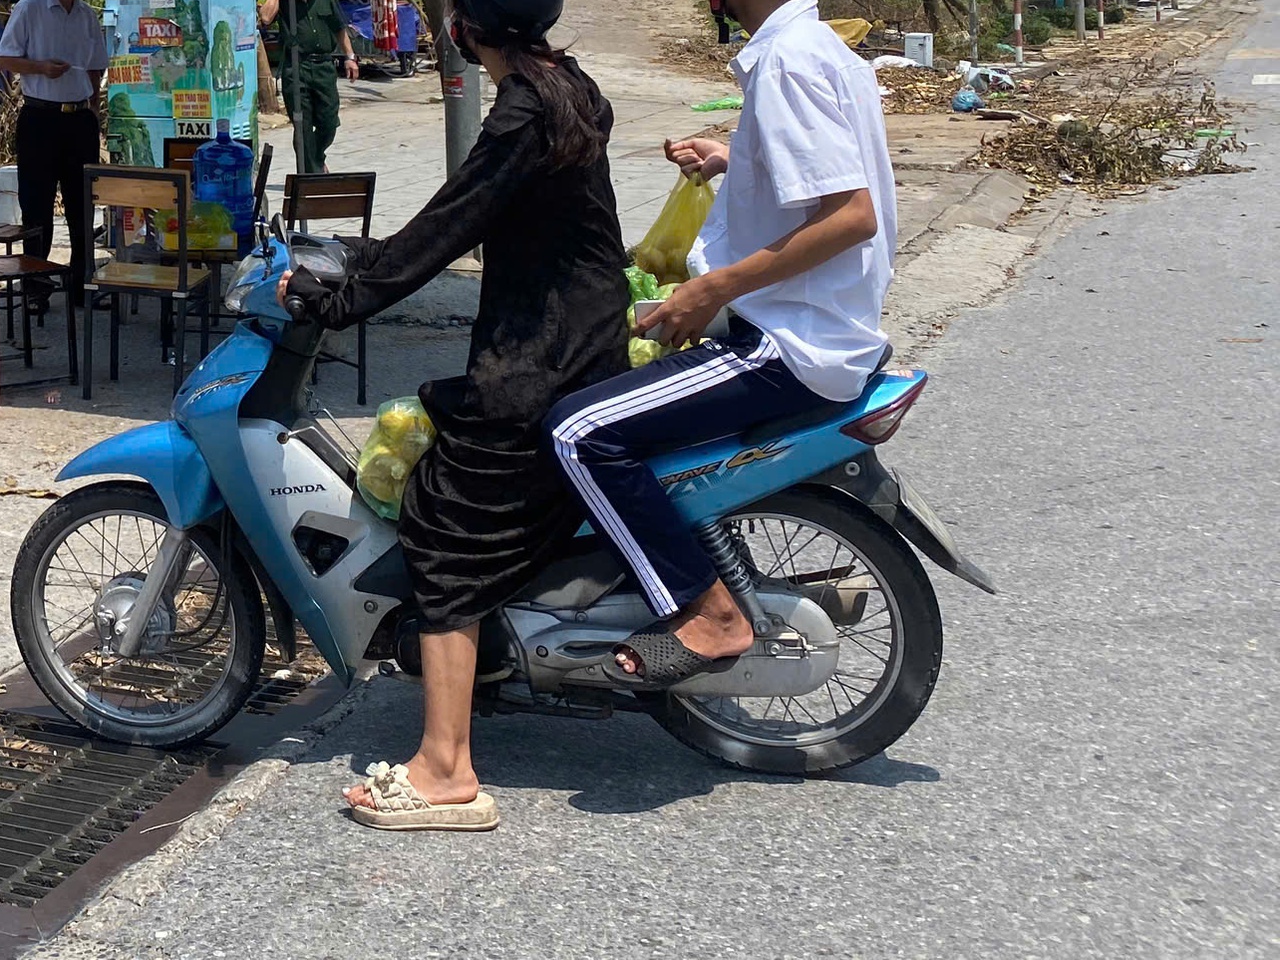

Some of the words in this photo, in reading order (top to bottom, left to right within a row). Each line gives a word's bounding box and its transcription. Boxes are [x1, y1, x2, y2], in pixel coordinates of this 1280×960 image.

[144, 24, 177, 37] TAXI
[177, 122, 210, 136] TAXI
[660, 460, 724, 486] WAVE
[270, 483, 326, 496] HONDA
